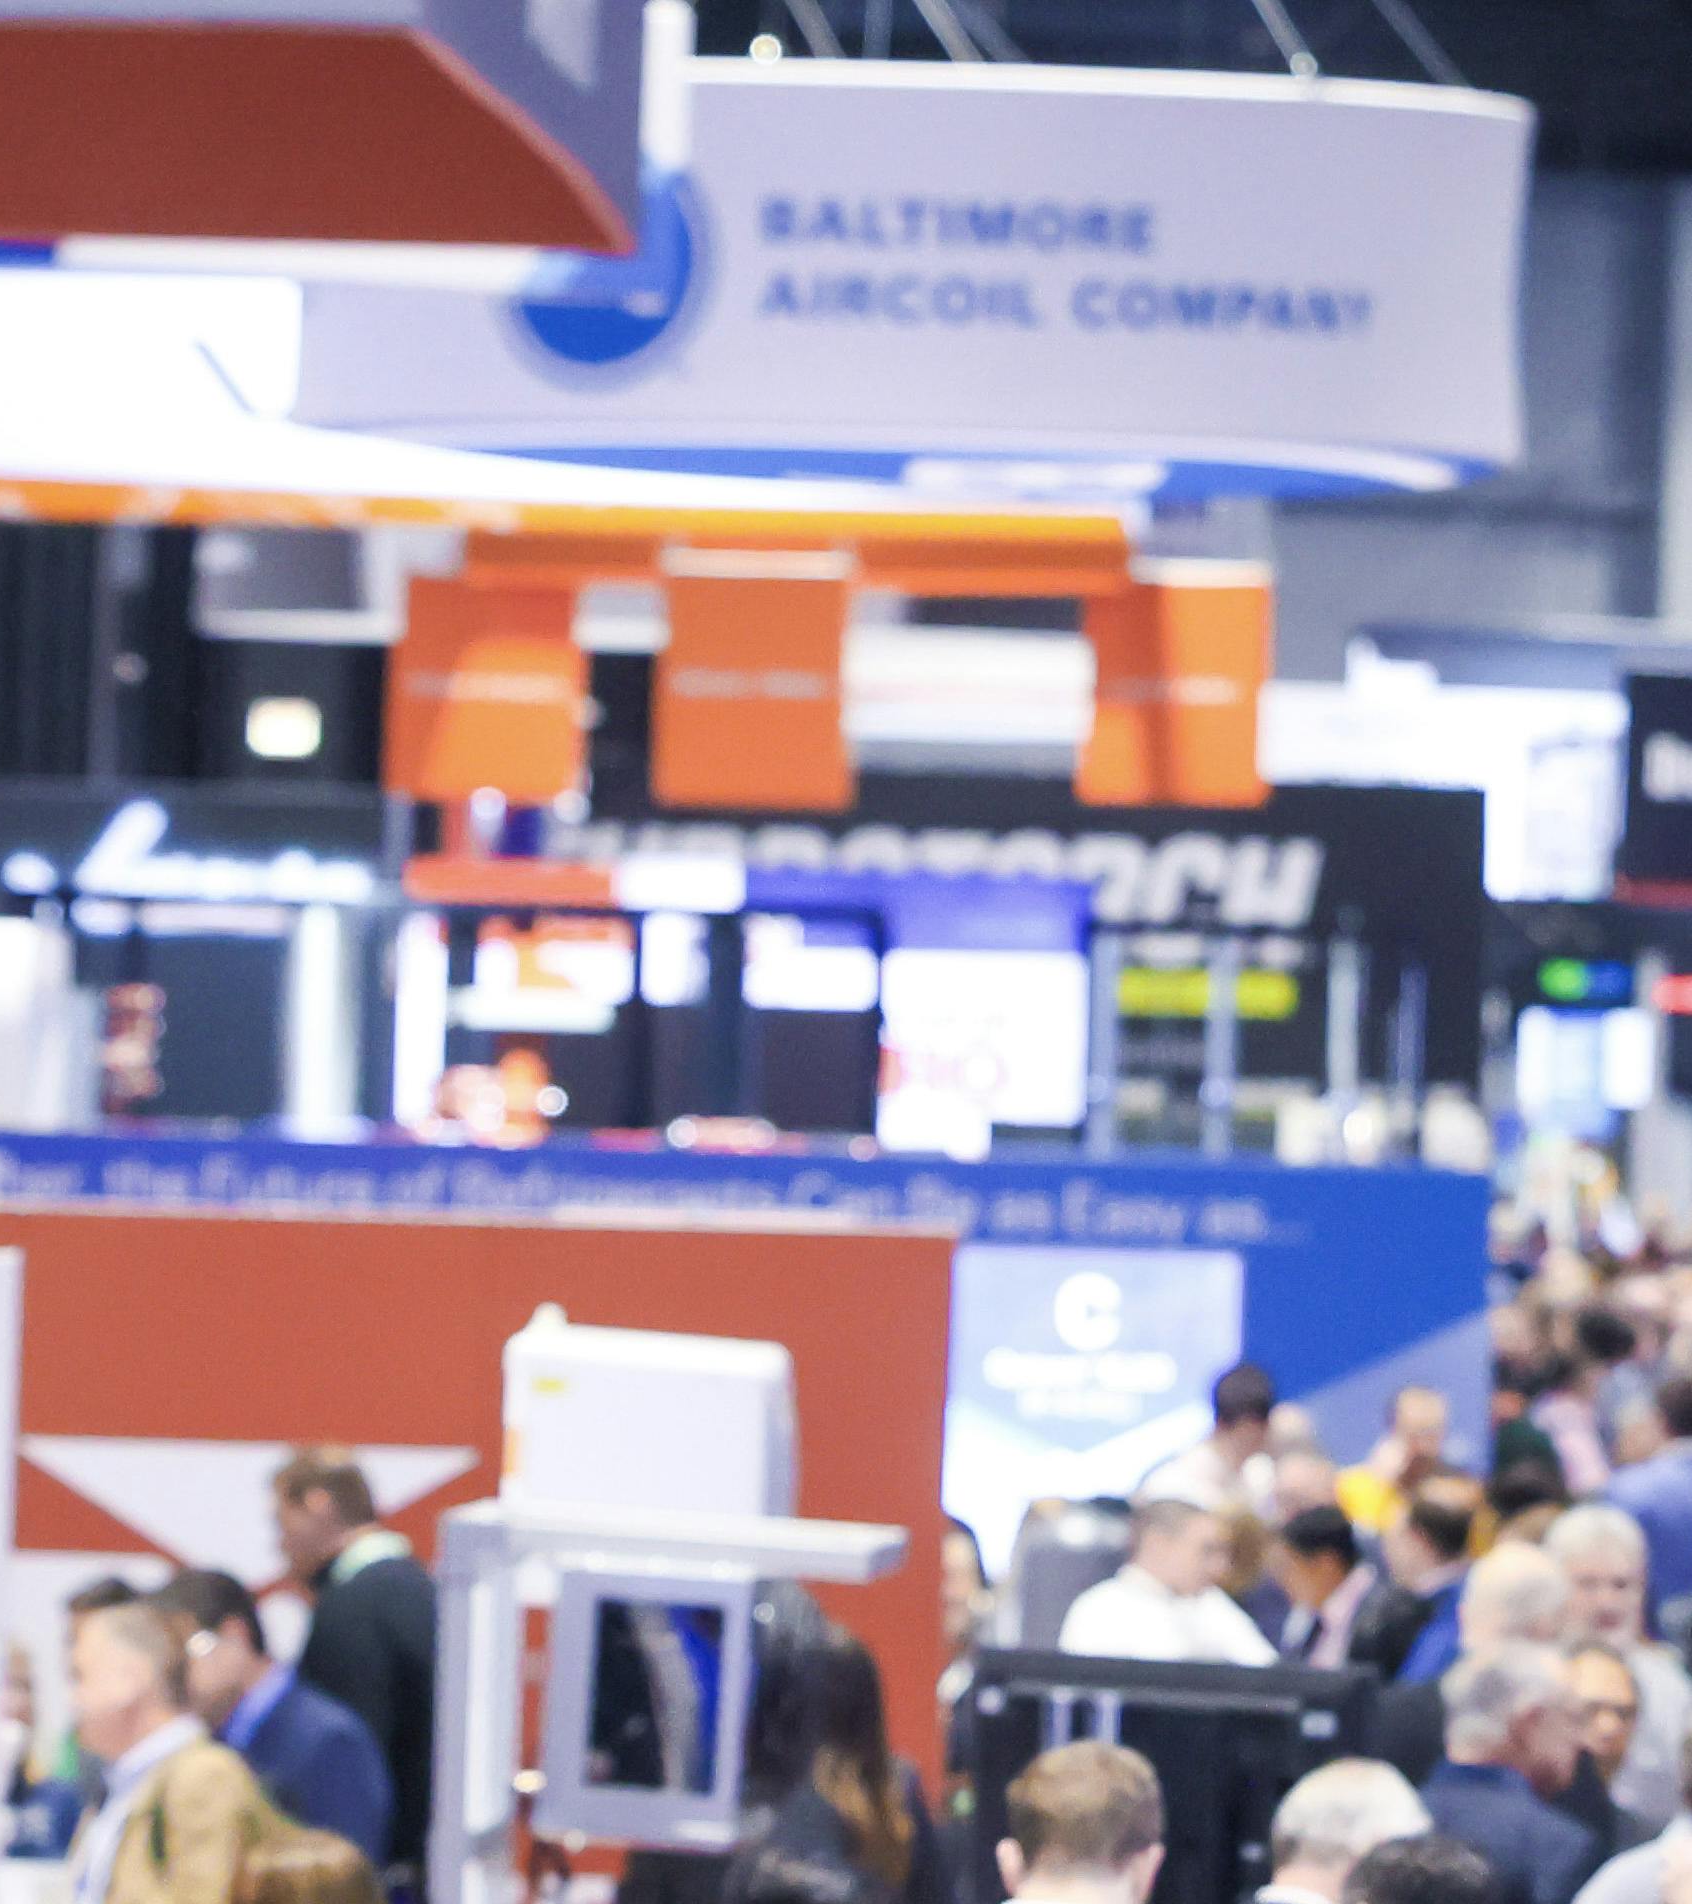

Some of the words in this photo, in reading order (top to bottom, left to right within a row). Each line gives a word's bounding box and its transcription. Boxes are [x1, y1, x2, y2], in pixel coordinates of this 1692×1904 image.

[760, 199, 1156, 254] BALTIMORE
[761, 272, 1038, 326] AIRCOIL
[1072, 277, 1372, 330] COMPANY
